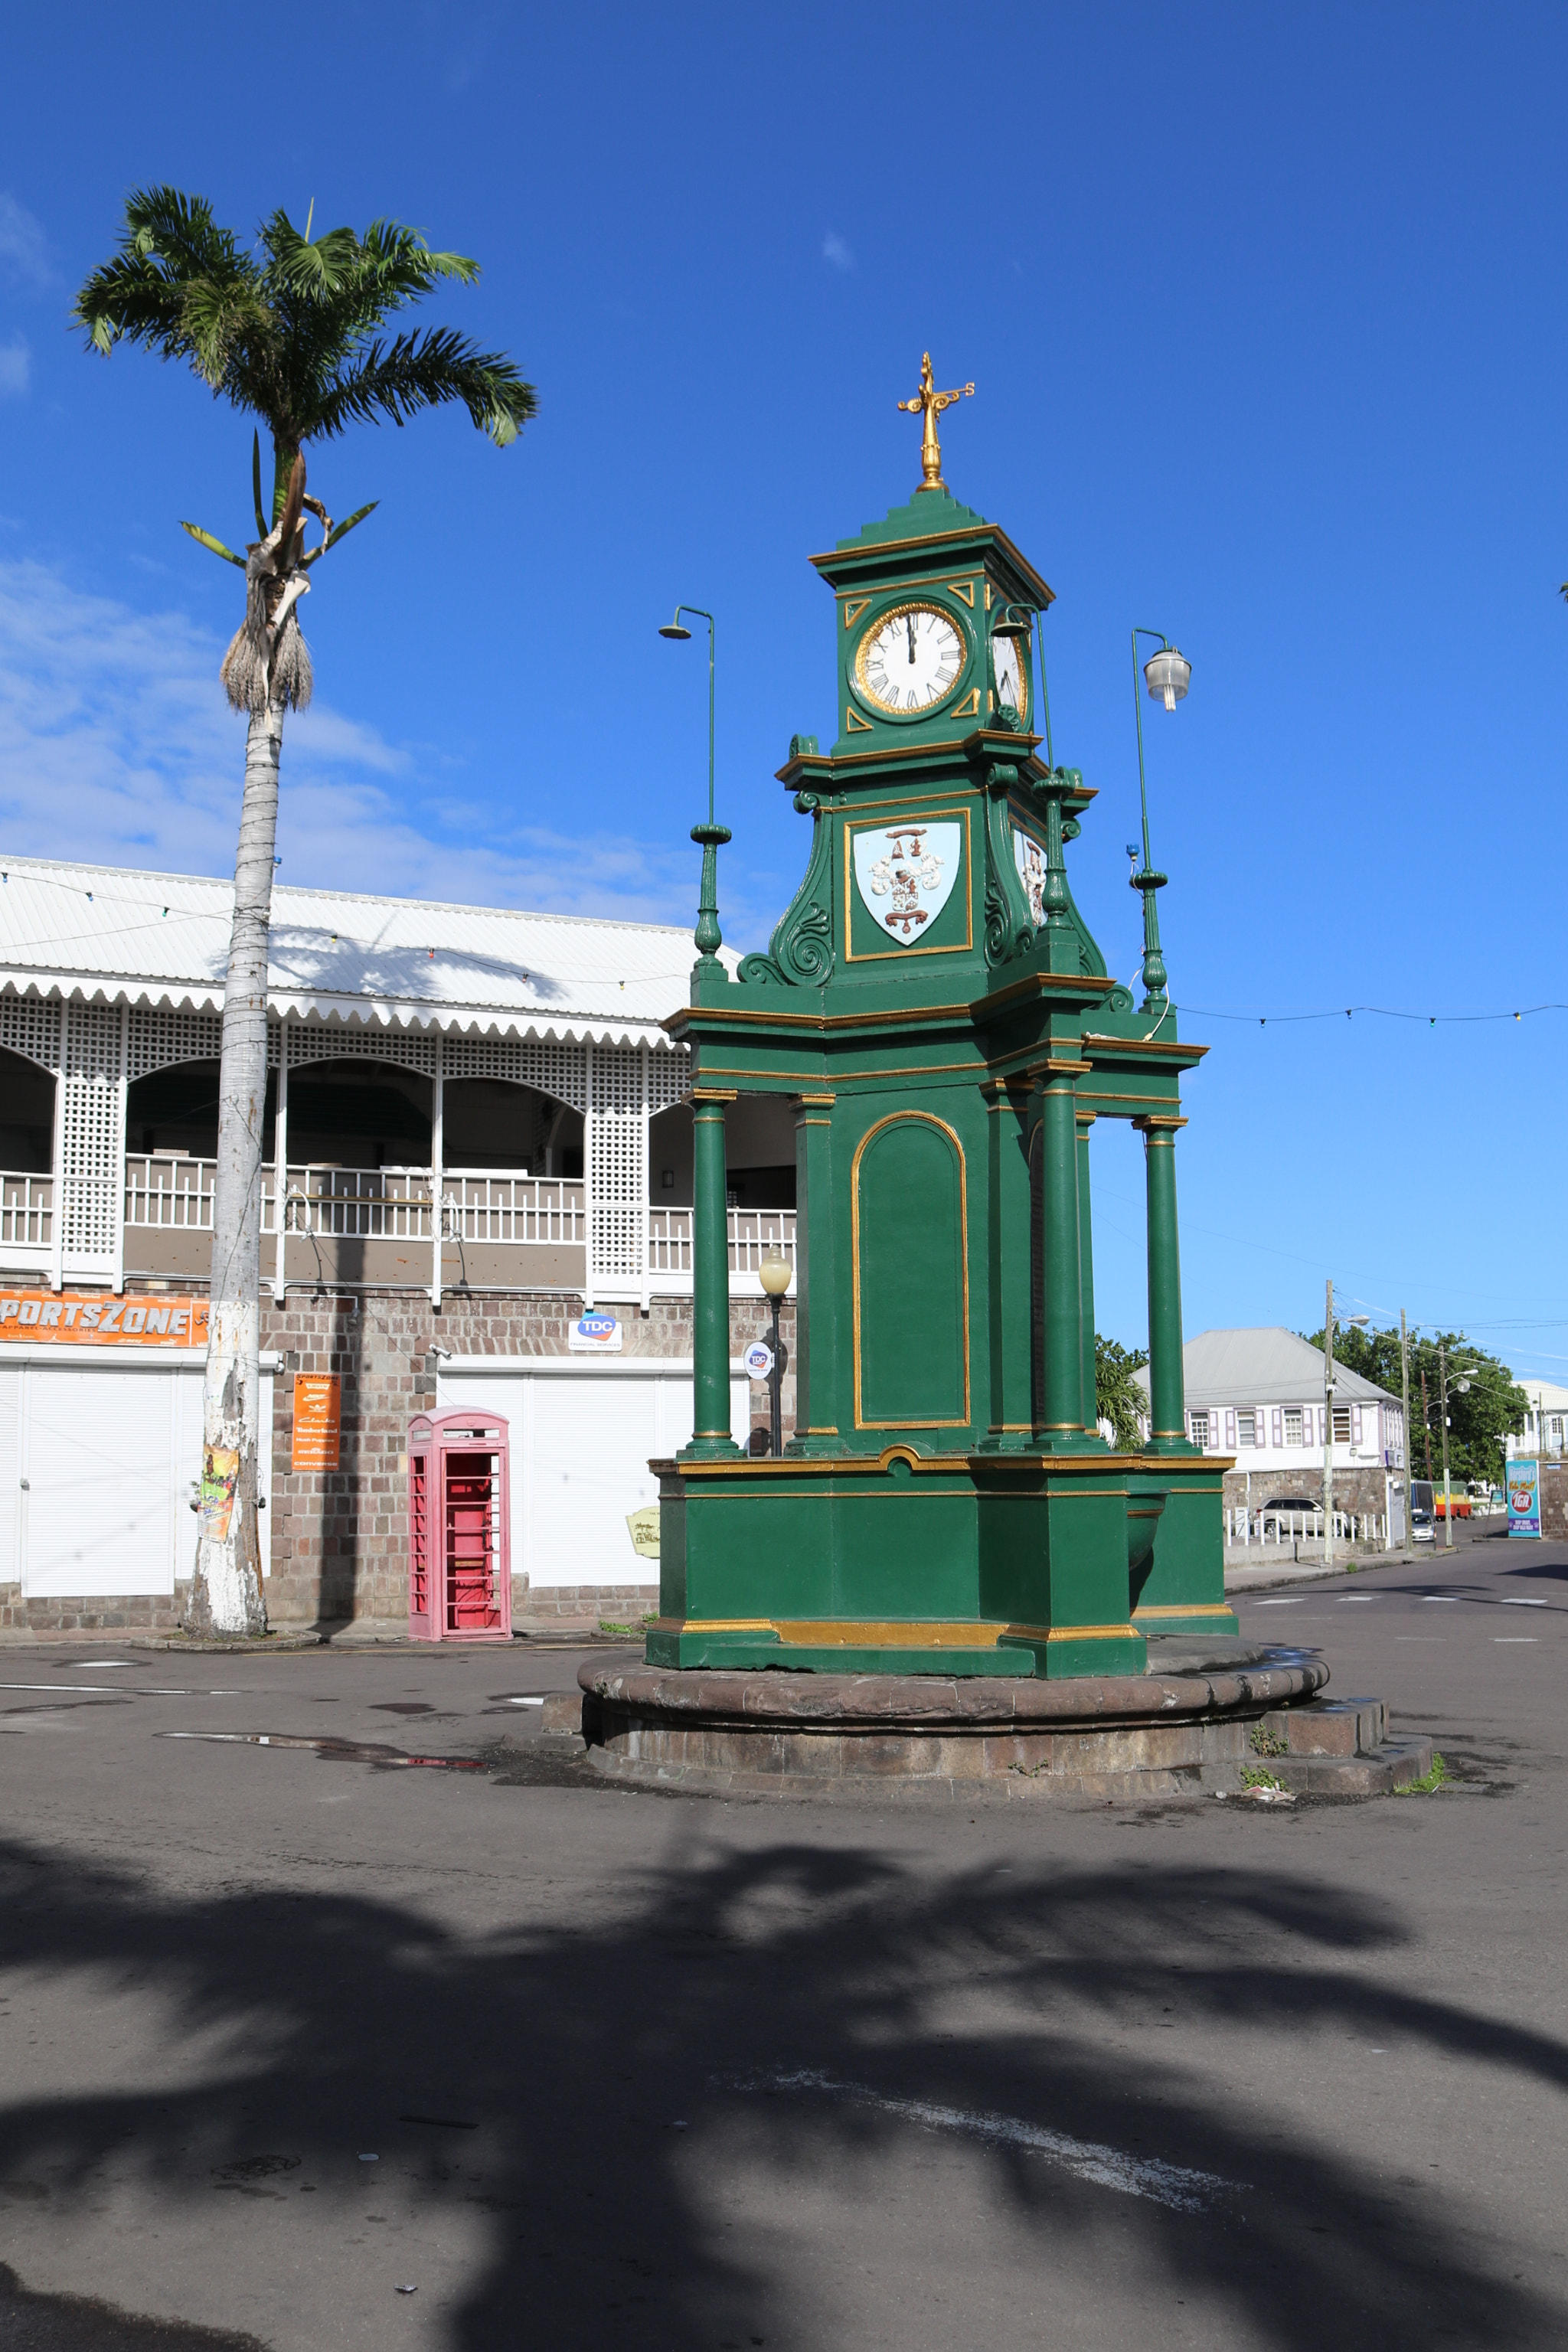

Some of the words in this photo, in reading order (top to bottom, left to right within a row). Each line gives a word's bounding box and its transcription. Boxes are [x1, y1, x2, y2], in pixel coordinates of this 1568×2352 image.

[0, 1299, 191, 1335] PORTSZONE
[582, 1321, 613, 1332] TDC
[1512, 1493, 1530, 1508] IGA
